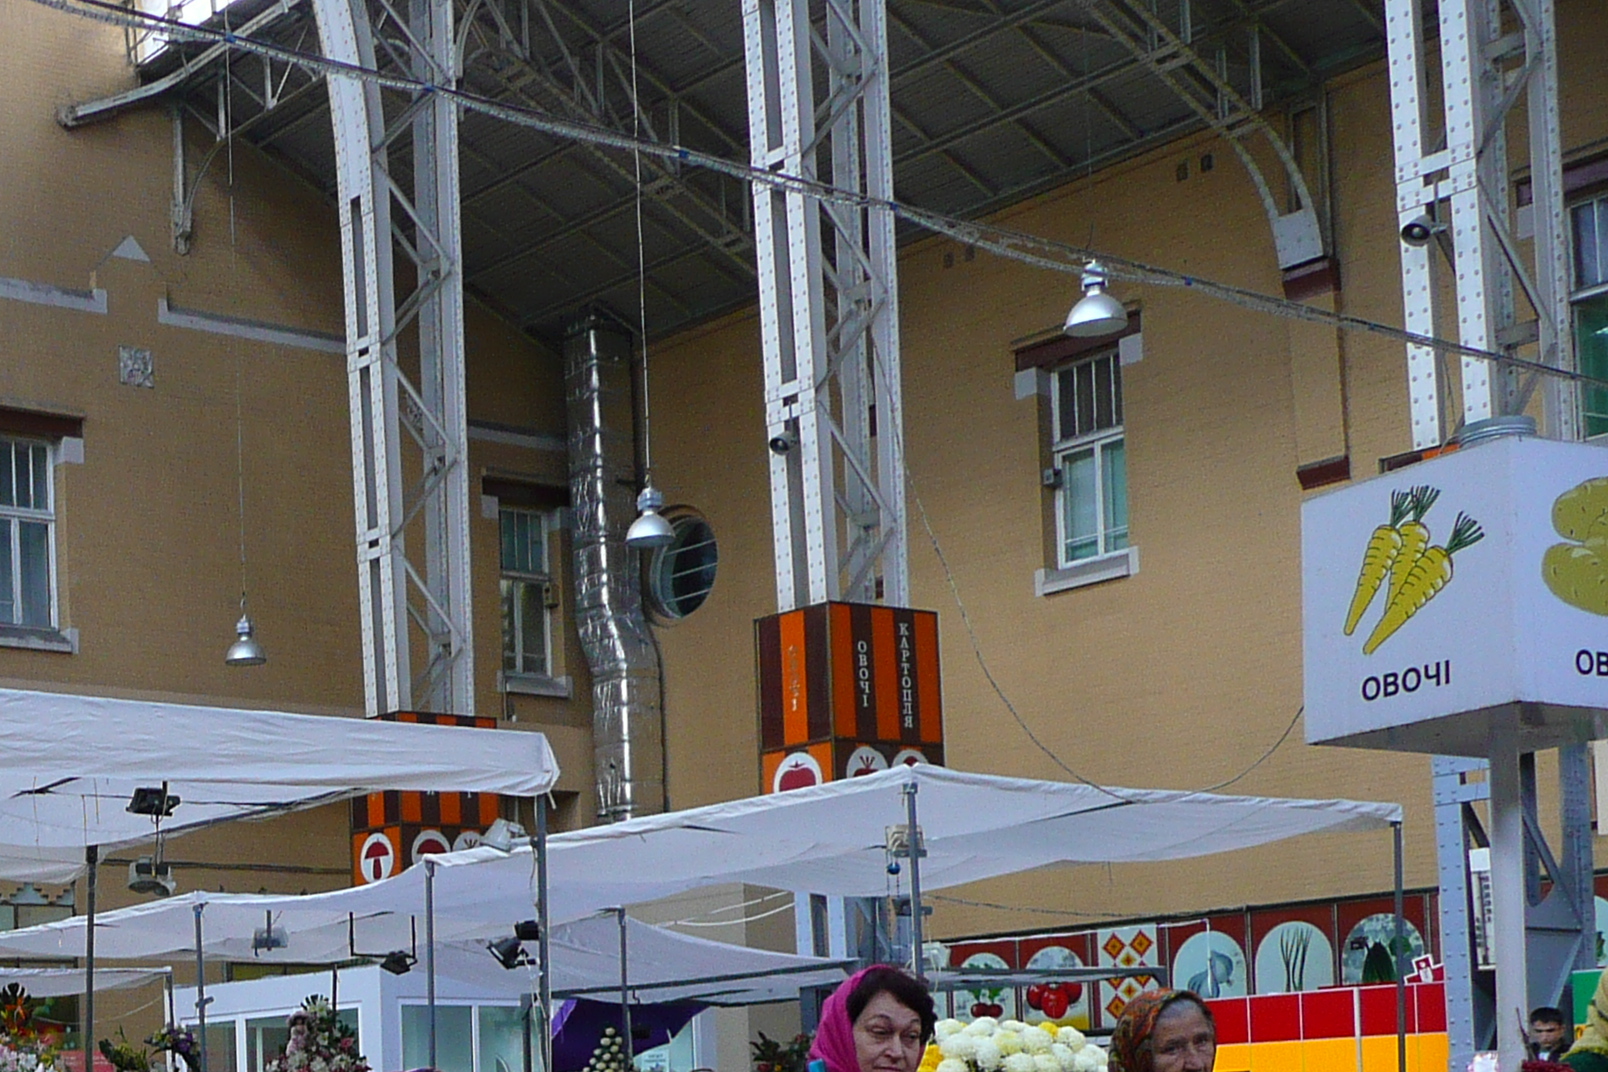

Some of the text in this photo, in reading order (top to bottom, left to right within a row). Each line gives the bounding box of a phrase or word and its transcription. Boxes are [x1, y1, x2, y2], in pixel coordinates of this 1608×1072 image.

[857, 640, 869, 707] ОВОЧІ
[899, 622, 913, 728] КАРТОПЛЯ
[1361, 659, 1451, 701] ОВОЧІ
